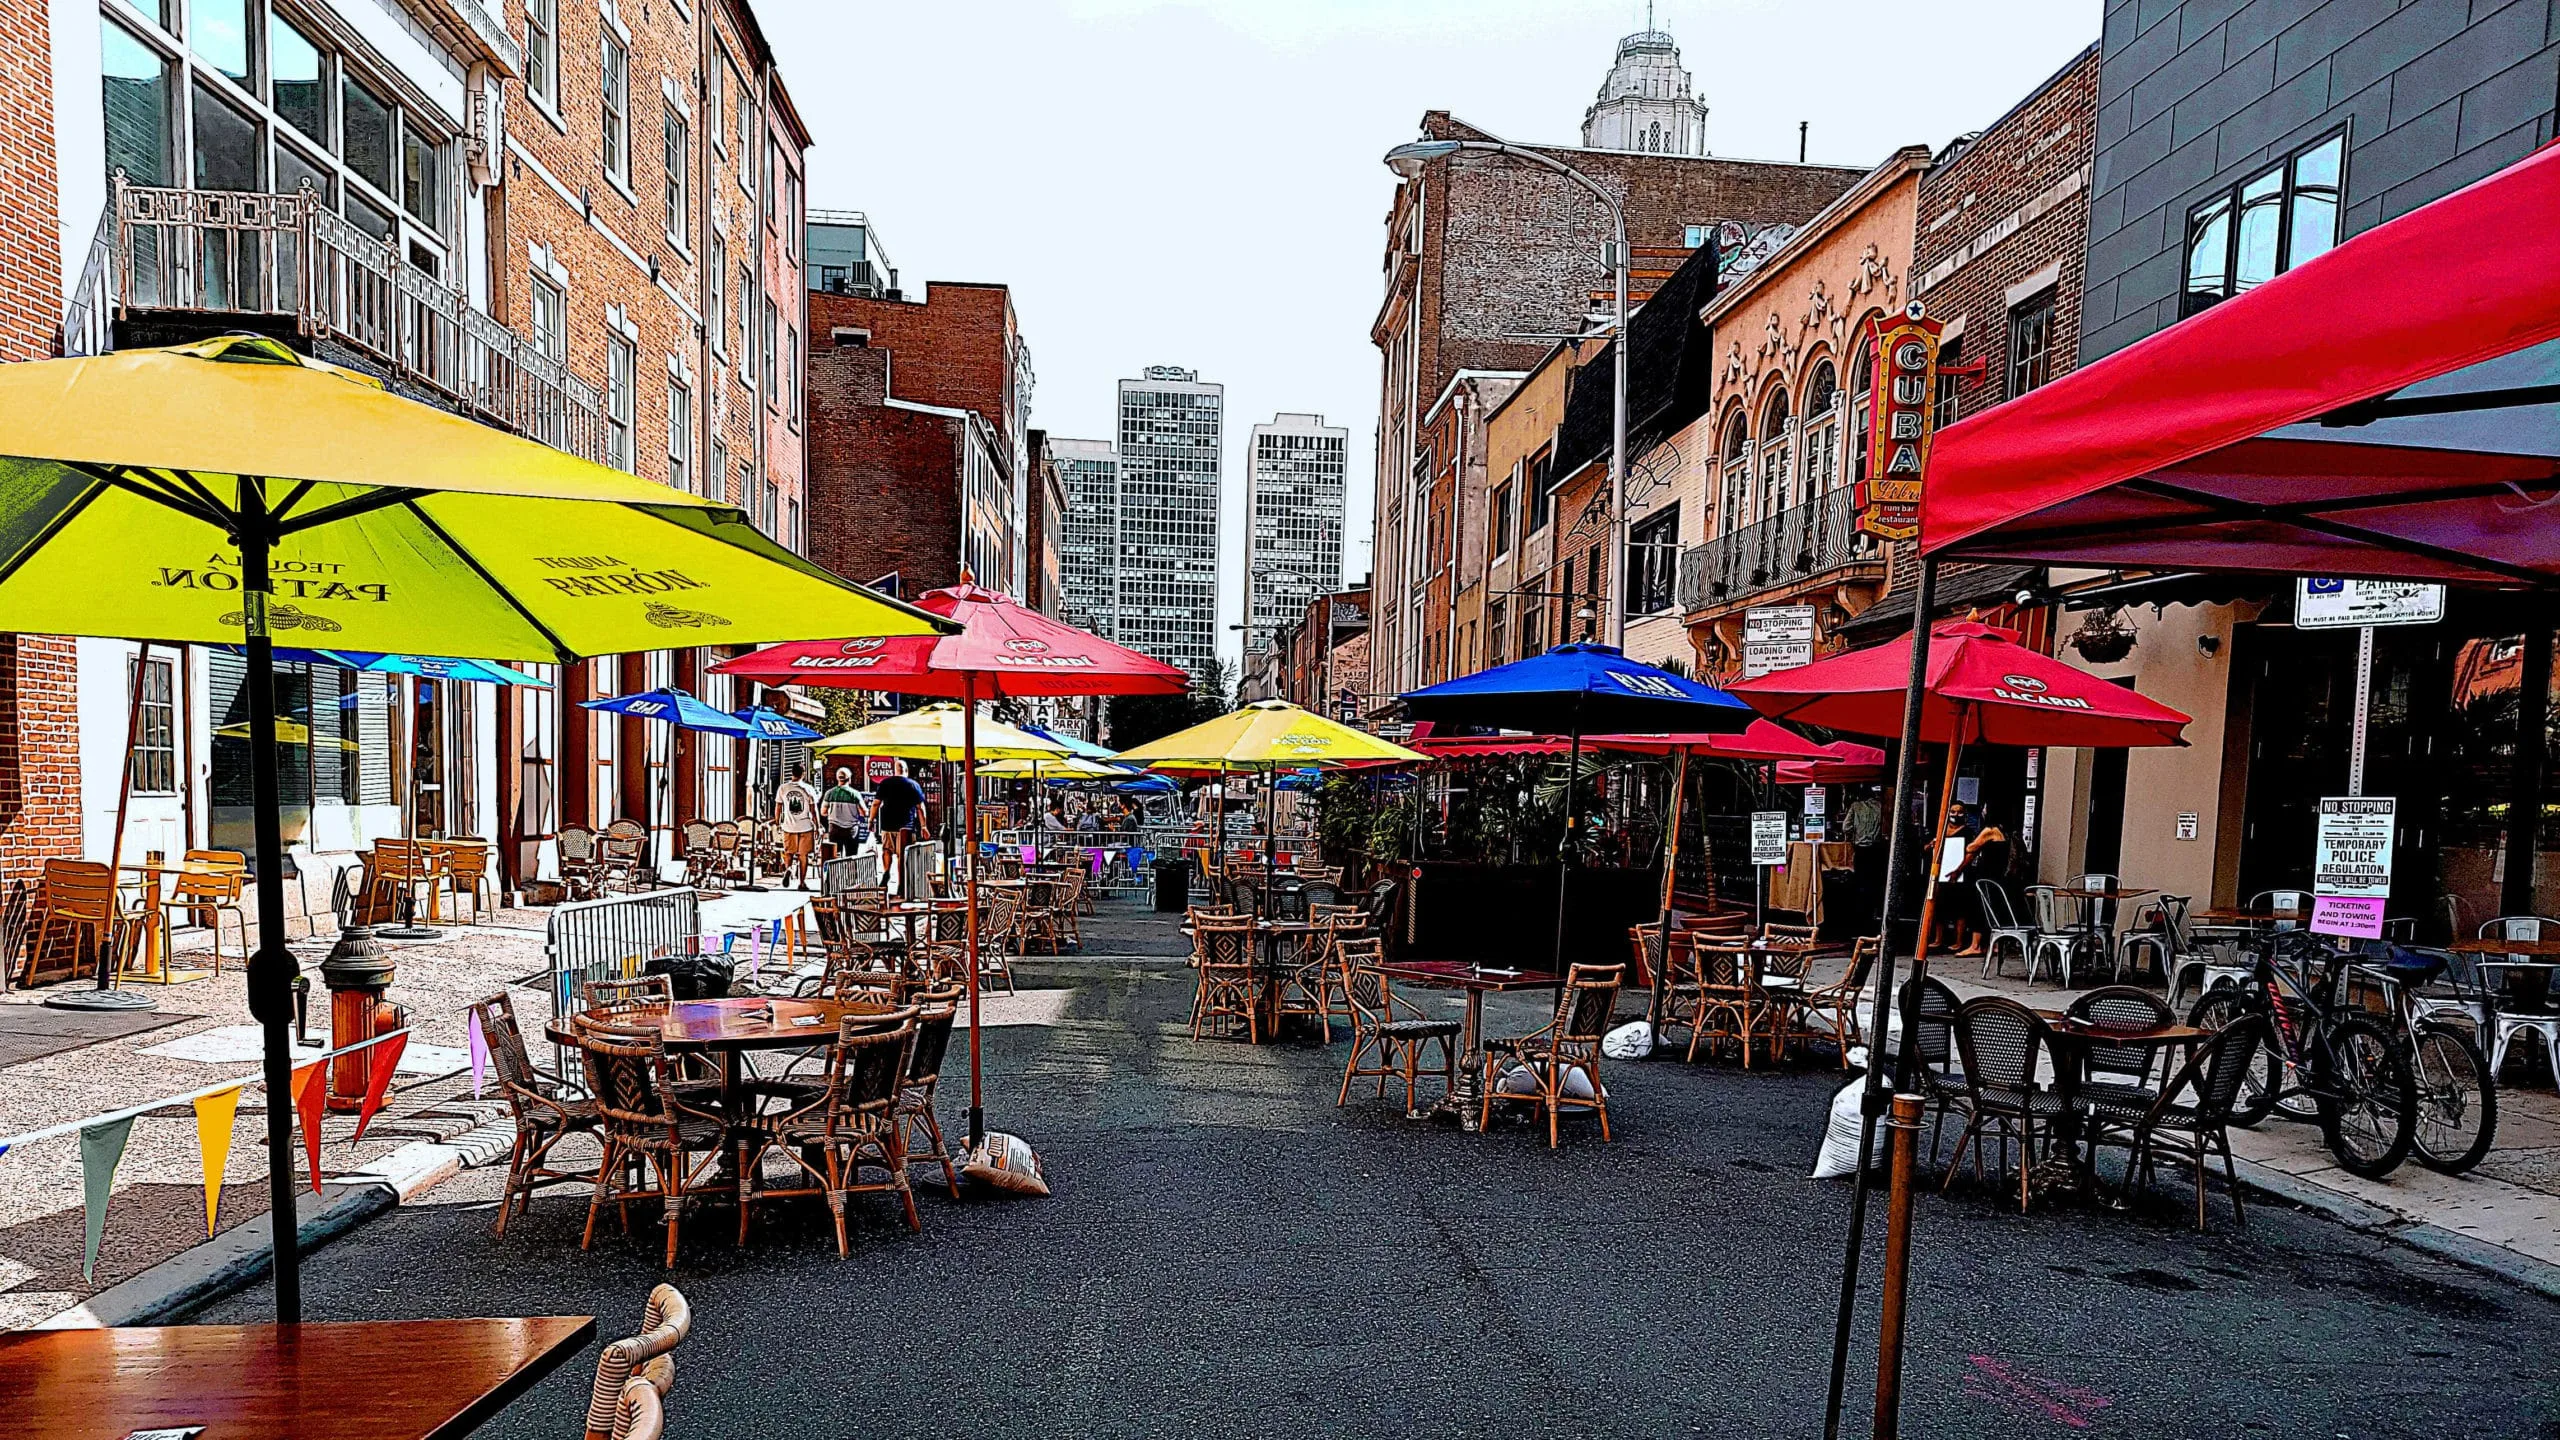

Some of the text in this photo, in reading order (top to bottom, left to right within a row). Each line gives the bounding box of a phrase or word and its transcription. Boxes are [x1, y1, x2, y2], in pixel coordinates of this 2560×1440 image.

[1887, 341, 1928, 474] CUBA
[1901, 504, 1914, 512] bar
[533, 555, 627, 570] TEQUILA
[1750, 619, 1803, 628] NO STOPPING
[1749, 645, 1807, 655] LOADING ONLY
[869, 769, 893, 777] 24 HRS
[2324, 801, 2391, 813] NO STOPPING
[2324, 839, 2386, 850] TEMPORARY
[2331, 850, 2376, 863] POLICE
[2322, 863, 2384, 875] REGULATION
[2328, 901, 2372, 910] TICKETING
[2341, 912, 2376, 921] TOWING
